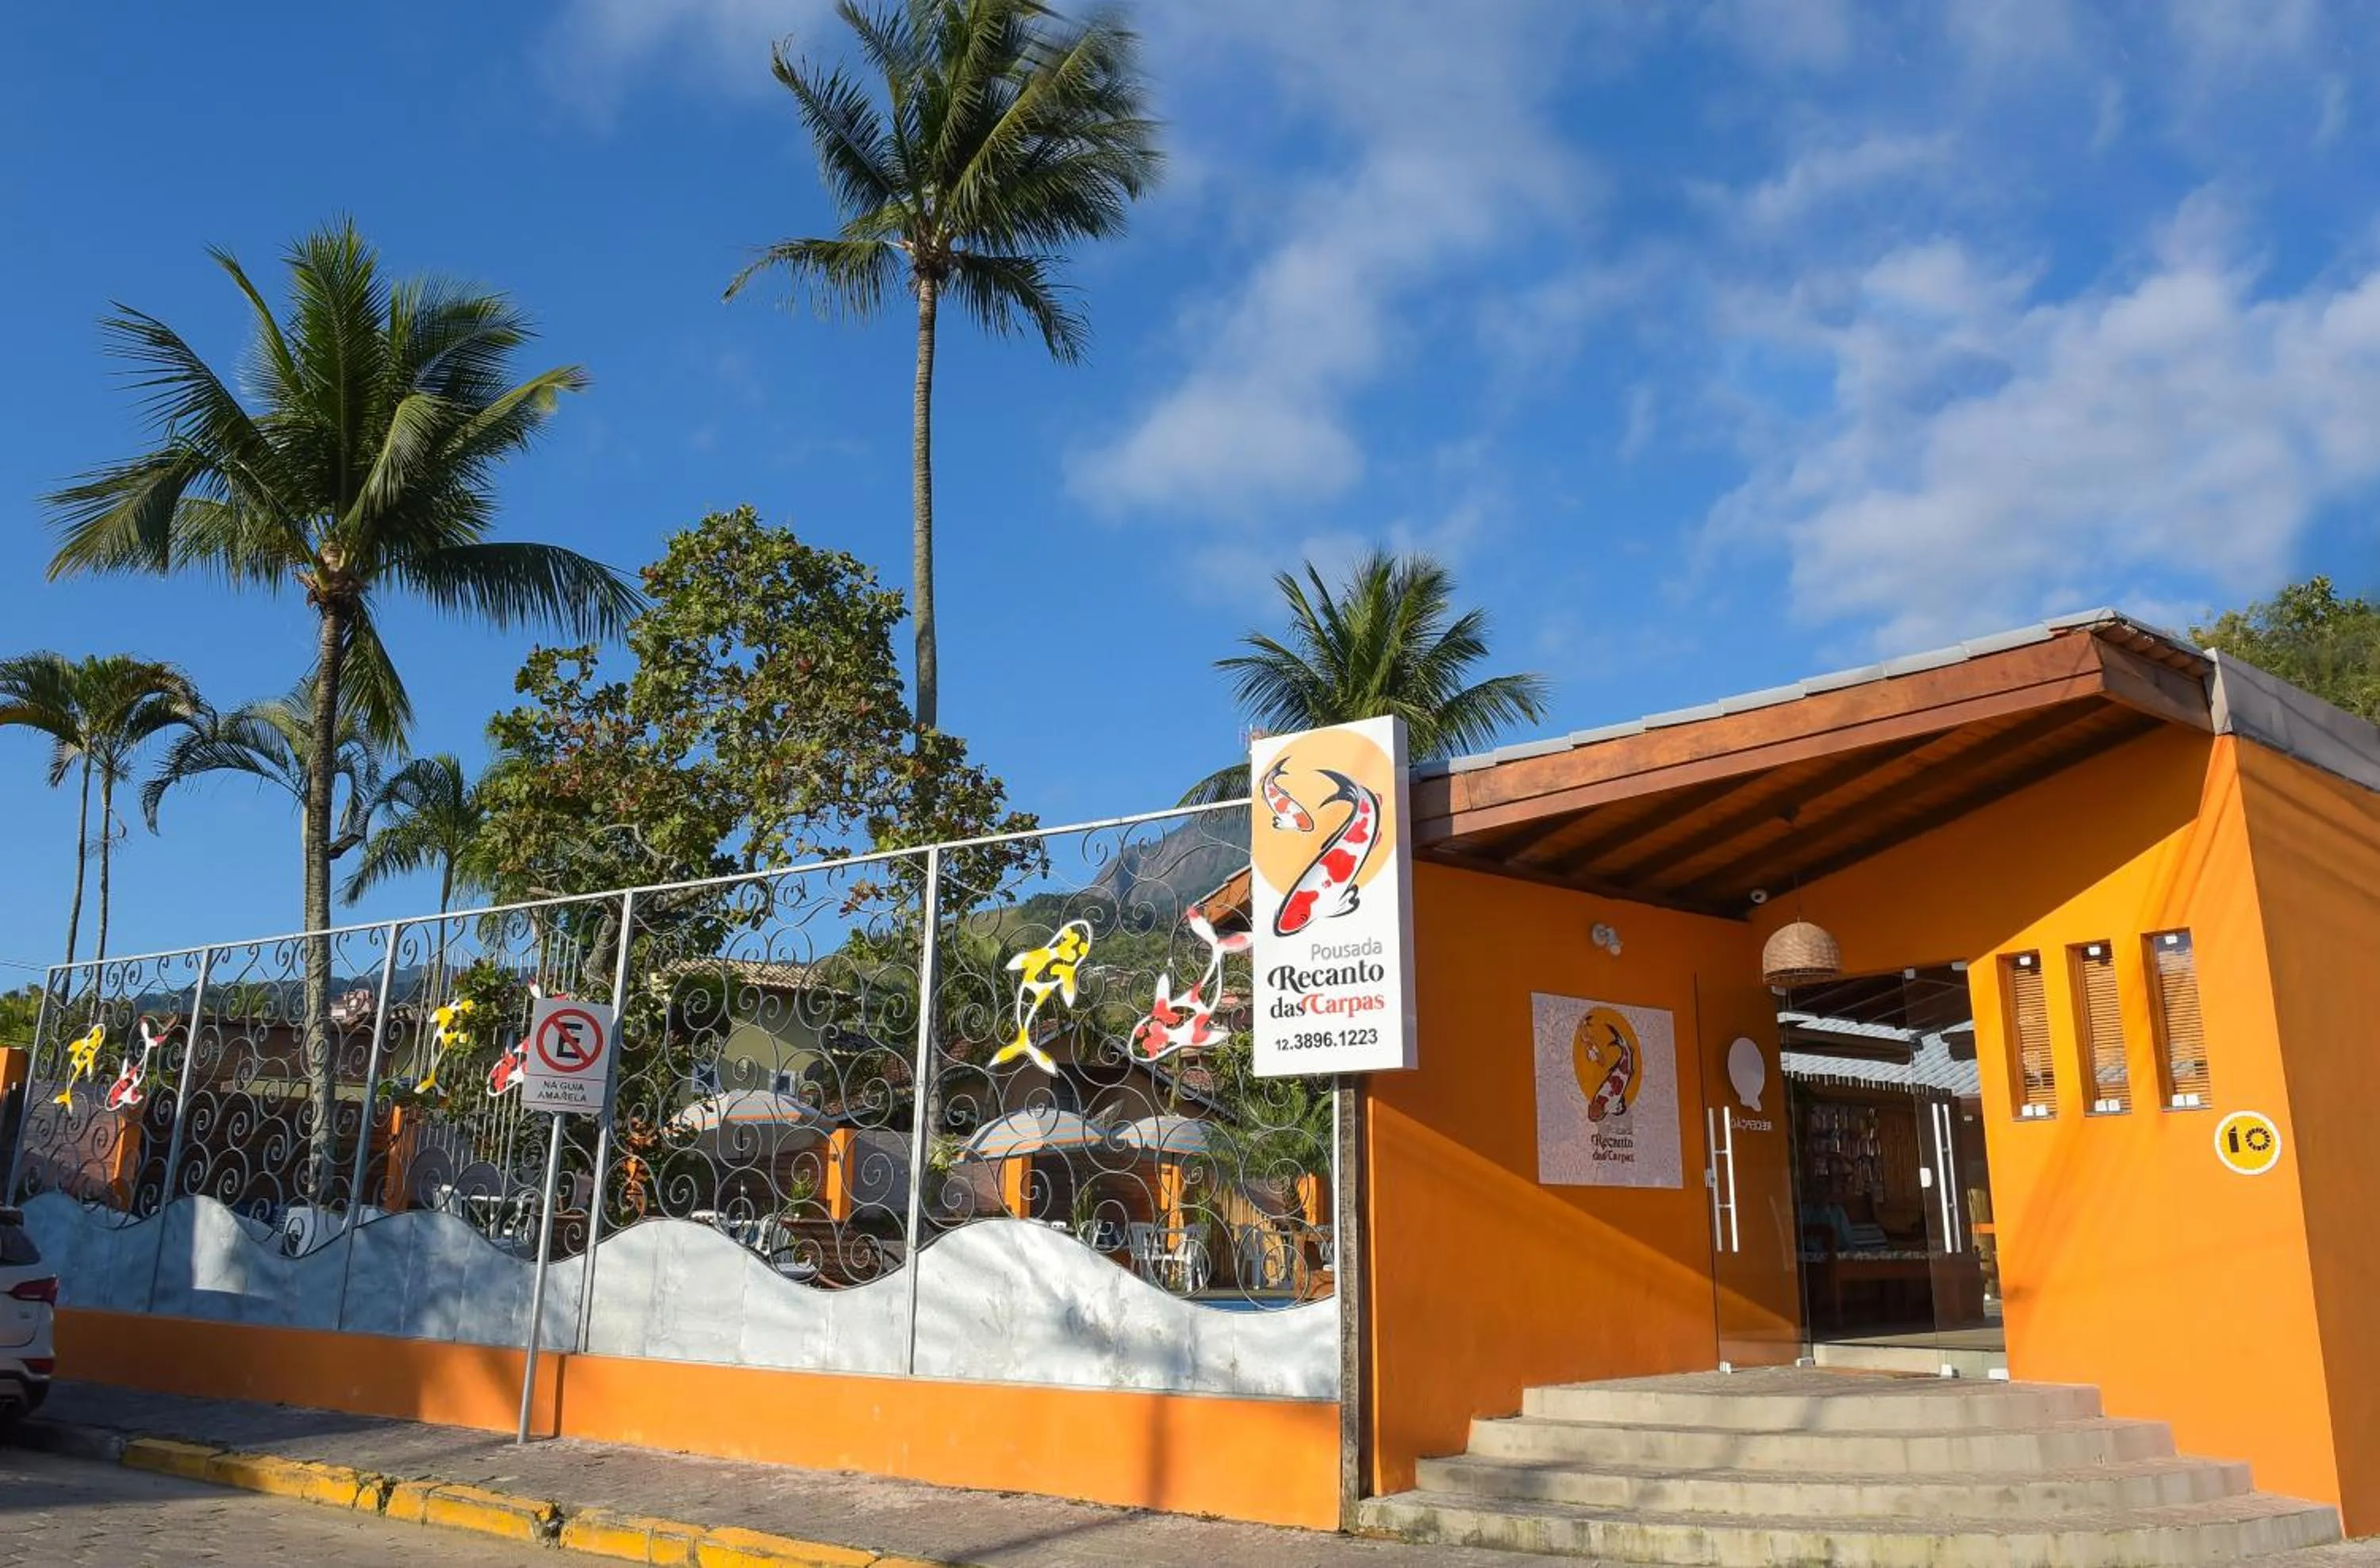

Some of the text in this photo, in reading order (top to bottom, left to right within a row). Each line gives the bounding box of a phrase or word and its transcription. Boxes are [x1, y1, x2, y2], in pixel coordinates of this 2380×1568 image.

[1311, 937, 1383, 961] Pousada
[1267, 959, 1385, 993] Recanto
[1270, 993, 1385, 1019] das Carpas
[557, 1022, 583, 1059] E
[1276, 1028, 1379, 1051] 12.3896.1223
[543, 1080, 585, 1091] NA GUIA
